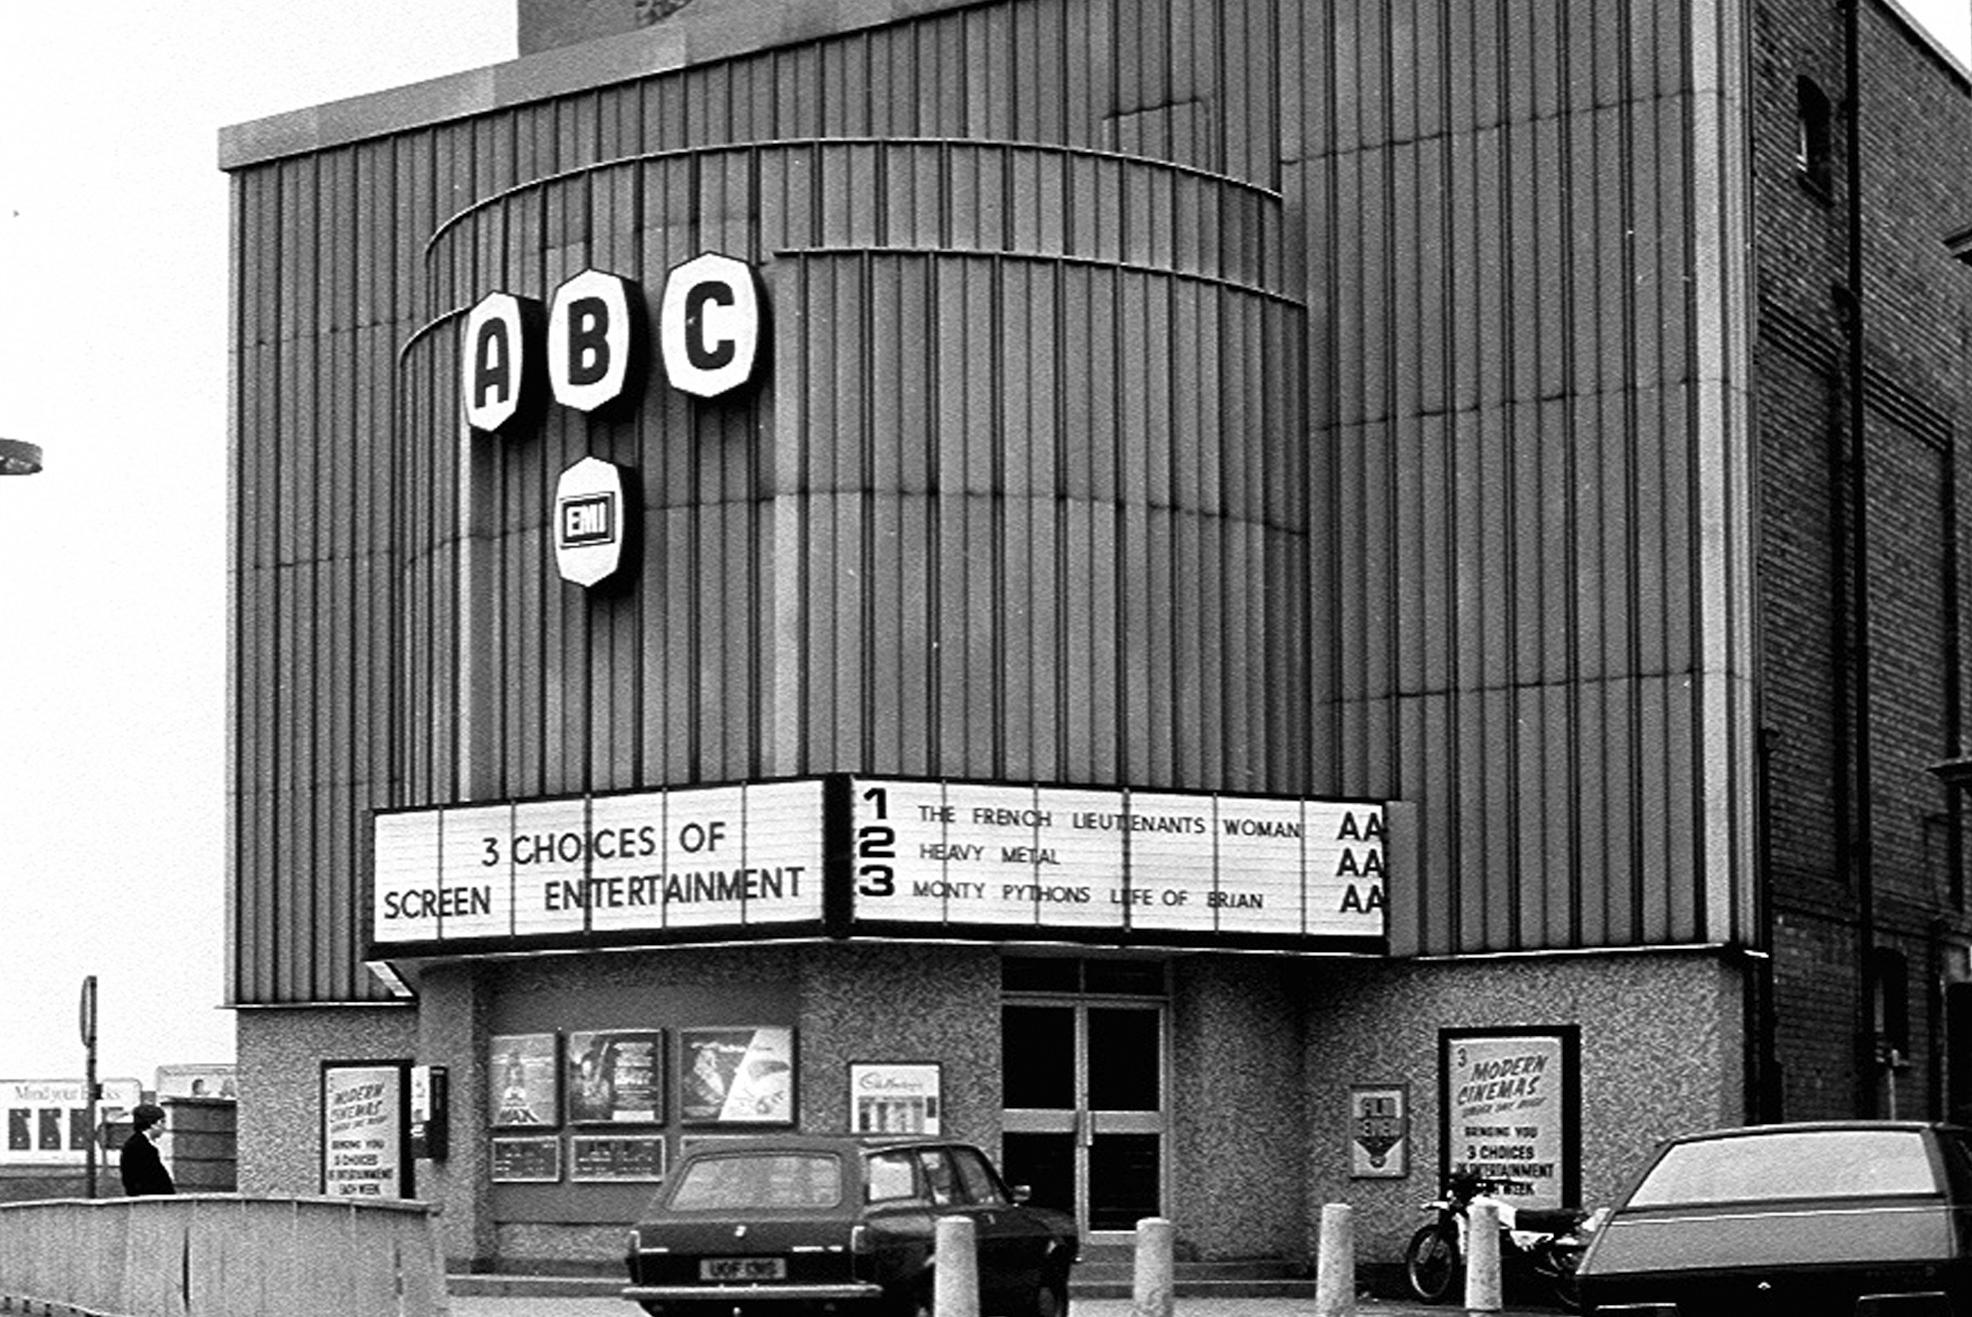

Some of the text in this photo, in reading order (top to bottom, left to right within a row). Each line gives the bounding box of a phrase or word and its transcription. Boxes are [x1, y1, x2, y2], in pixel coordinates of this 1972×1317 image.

[566, 502, 606, 537] EMI
[864, 788, 1384, 841] 1 THE FRENCH LIEUTENANTS WOMAN AA
[482, 837, 500, 866] 3
[680, 821, 726, 853] OF
[859, 827, 1384, 878] 2 HEAVY METAL AA
[384, 866, 805, 920] SCREEN ENTERTAINMENT
[859, 865, 895, 896] 3
[913, 881, 985, 899] MONTY
[1003, 884, 1090, 903] PYTHONS
[1162, 890, 1188, 906] OF
[1207, 891, 1264, 909] BRIAN
[1339, 884, 1385, 914] AA
[1458, 1047, 1549, 1082] 3 MODERN
[1457, 1075, 1541, 1106] CINEMAS
[1515, 1126, 1539, 1138] YOU
[1467, 1145, 1534, 1160] 3 CHOICES
